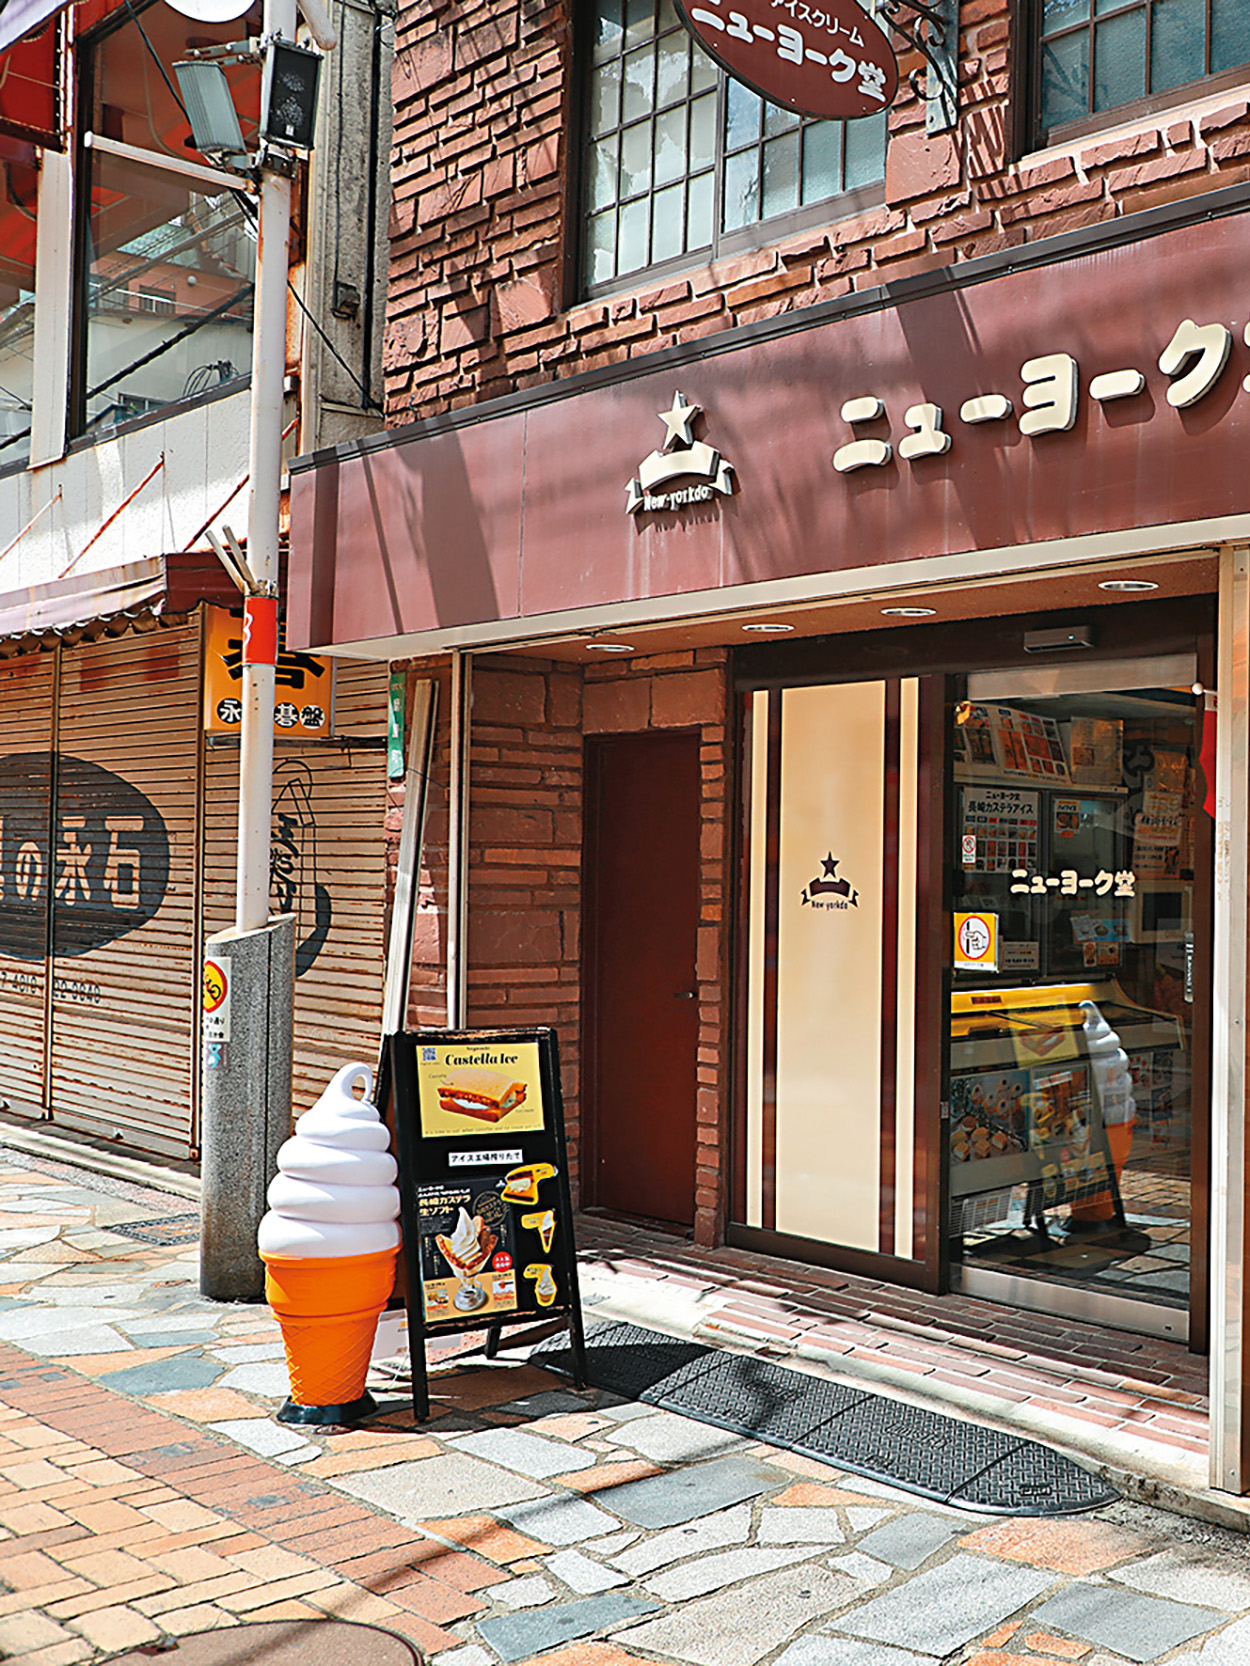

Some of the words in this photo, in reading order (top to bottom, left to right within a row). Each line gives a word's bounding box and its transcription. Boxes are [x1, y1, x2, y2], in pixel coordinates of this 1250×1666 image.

[691, 0, 886, 102] ニューヨーク堂
[968, 800, 1034, 814] 長崎カステラアイス
[1010, 868, 1136, 897] ニューヨーク堂
[445, 1053, 498, 1066] Castella
[500, 1053, 519, 1065] Ice
[419, 1194, 472, 1207] 長崎カステラ
